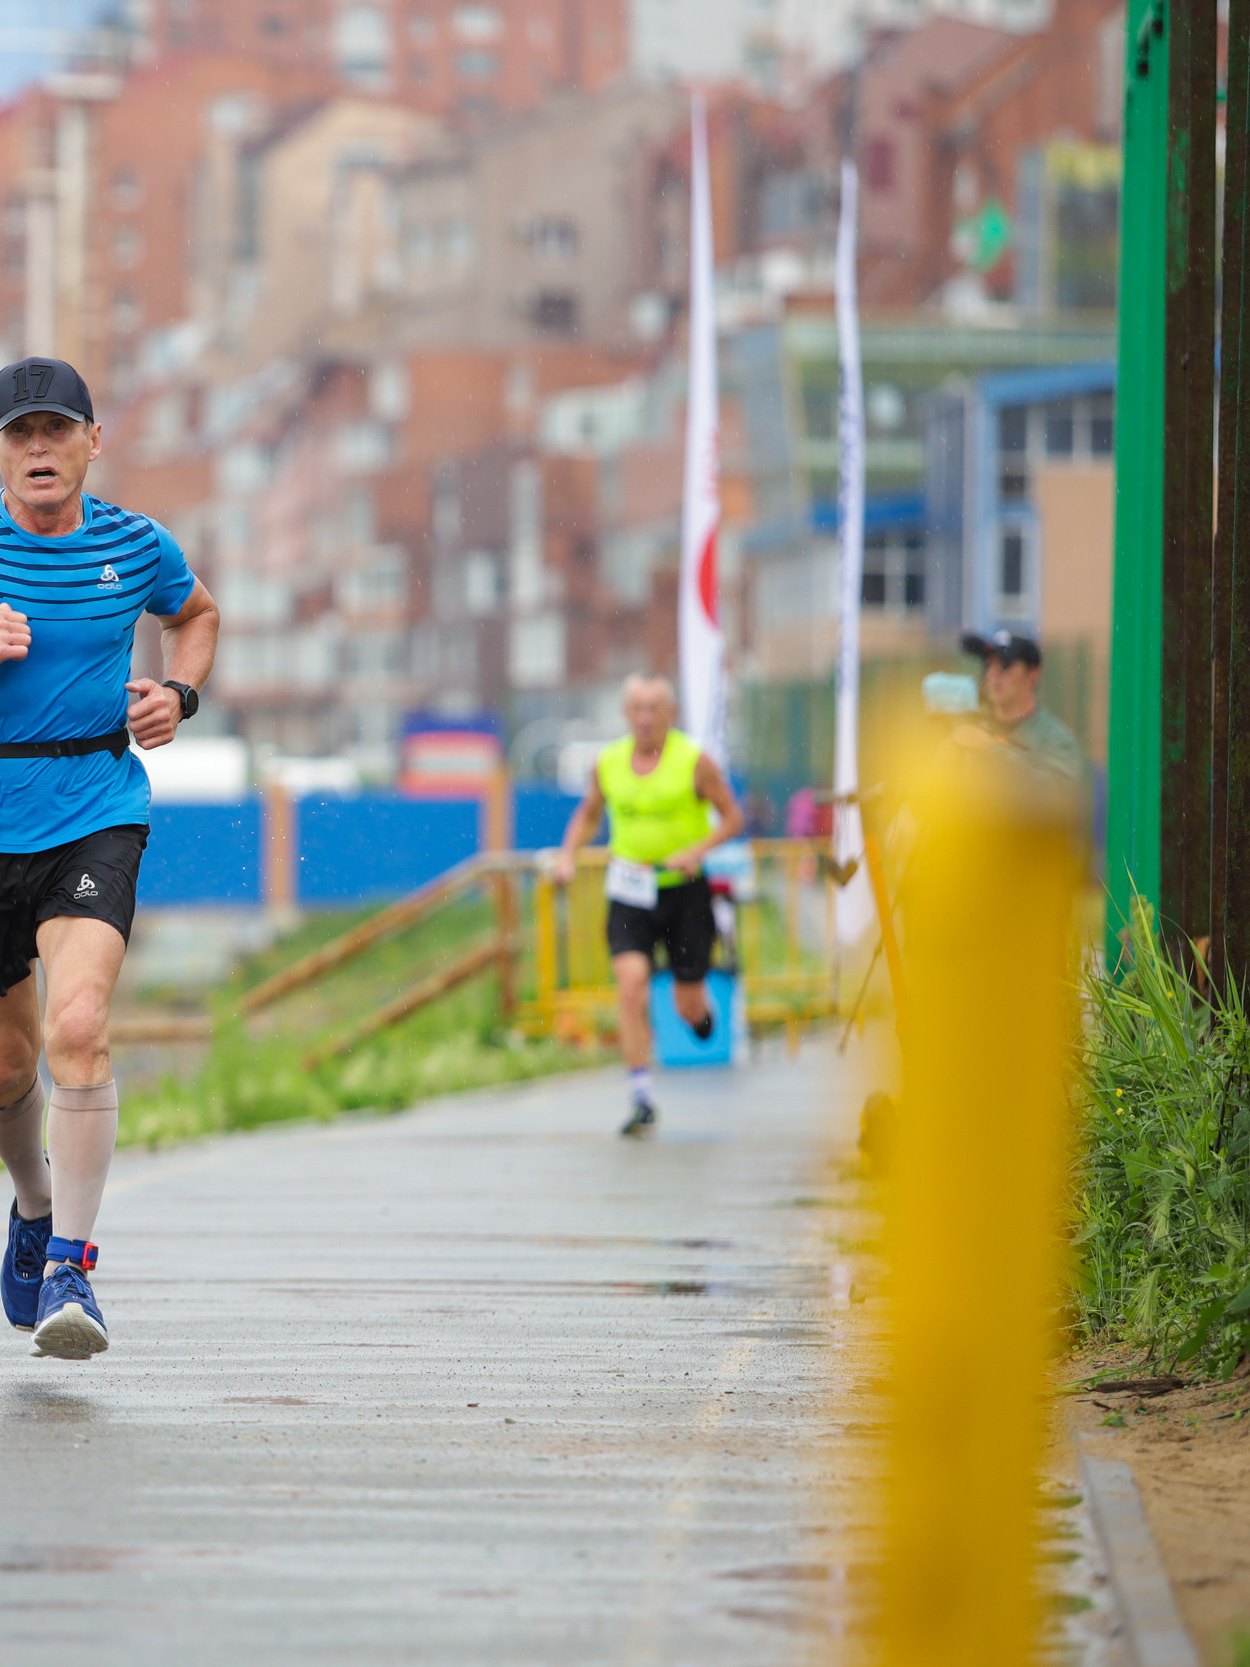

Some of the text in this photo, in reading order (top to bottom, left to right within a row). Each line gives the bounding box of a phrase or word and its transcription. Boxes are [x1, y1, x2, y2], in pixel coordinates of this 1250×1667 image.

[13, 364, 54, 403] 17
[97, 582, 123, 590] odlo
[73, 890, 98, 899] odlo
